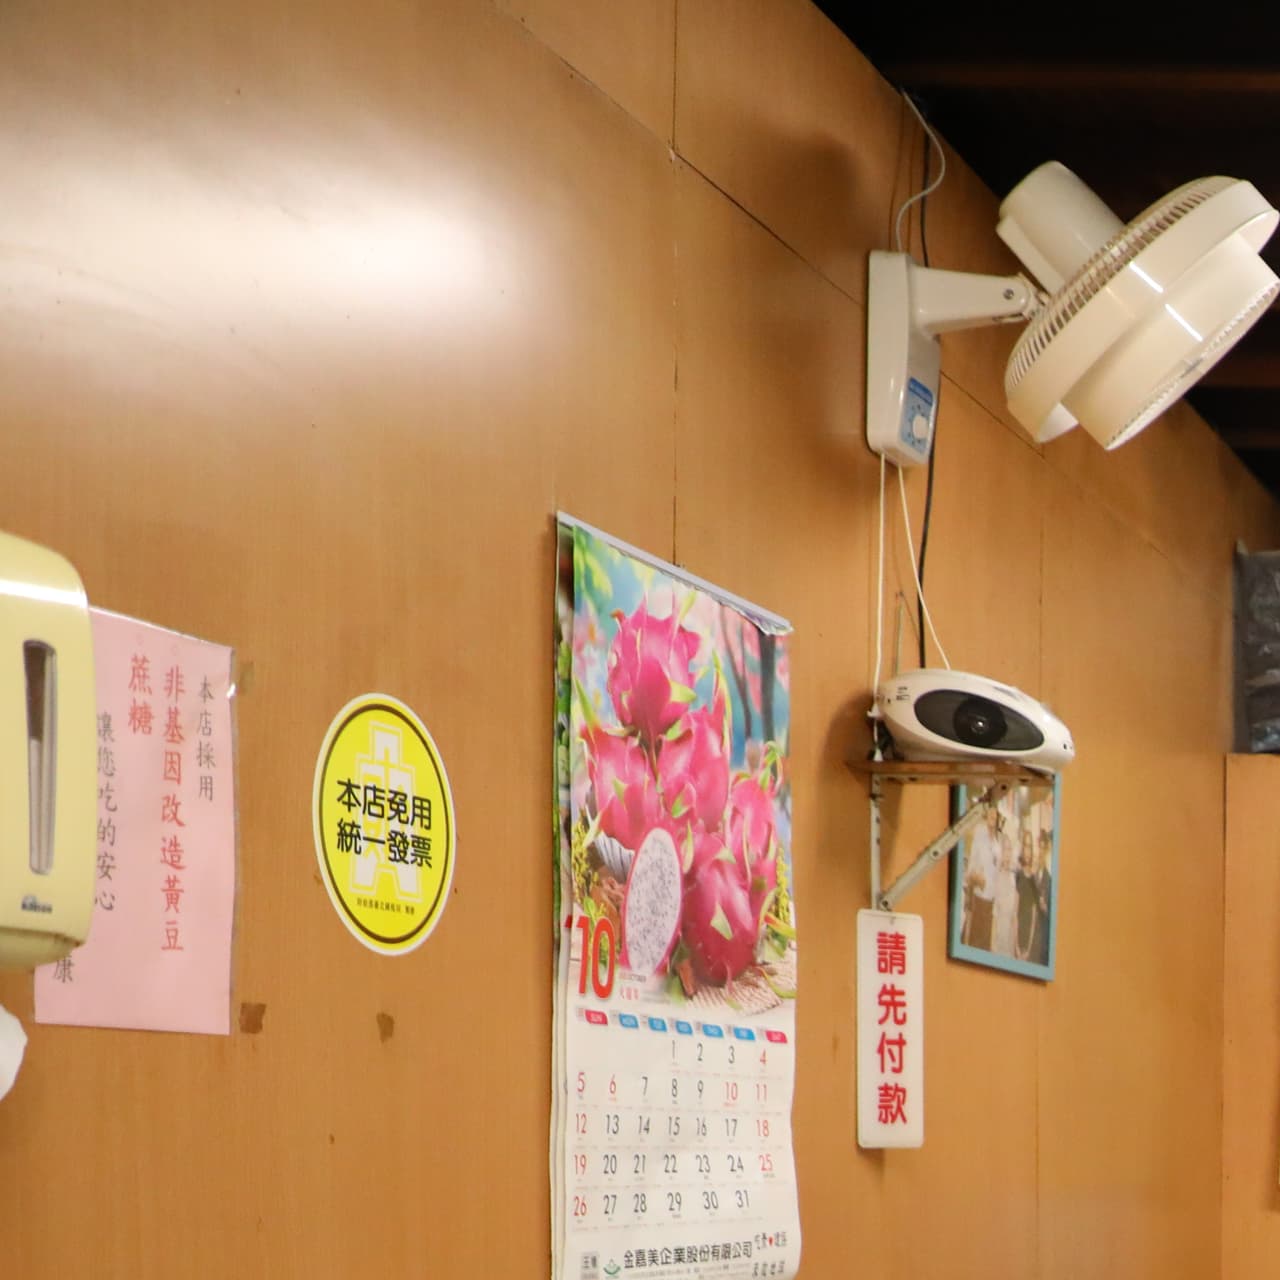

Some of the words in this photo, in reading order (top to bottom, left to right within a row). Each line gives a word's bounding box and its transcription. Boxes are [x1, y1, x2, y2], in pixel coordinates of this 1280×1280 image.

[127, 653, 155, 736] 蔗糖
[196, 675, 217, 802] 本店採用
[160, 665, 187, 953] 非基因改造黃豆
[337, 778, 432, 831] 本店免用
[337, 818, 432, 869] 統一發票
[576, 914, 615, 1001] 10
[671, 1040, 677, 1060] 1
[697, 1042, 704, 1062] 2
[728, 1045, 735, 1065] 3
[759, 1049, 767, 1065] 4
[876, 930, 908, 1126] 請先付款
[576, 1072, 585, 1094] 5
[609, 1074, 617, 1095] 6
[641, 1076, 649, 1096] 7
[671, 1078, 678, 1098] 8
[697, 1080, 704, 1099] 9
[724, 1081, 738, 1101] 10
[756, 1083, 767, 1101] 11
[575, 1113, 587, 1135] 12
[606, 1114, 620, 1135] 13
[638, 1115, 650, 1135] 14
[668, 1116, 681, 1136] 15
[696, 1117, 707, 1137] 16
[725, 1118, 738, 1137] 17
[756, 1119, 770, 1138] 18
[574, 1154, 587, 1175] 19
[603, 1154, 617, 1175] 20
[633, 1154, 646, 1174] 21
[664, 1154, 678, 1174] 22
[696, 1154, 711, 1173] 23
[727, 1154, 744, 1173] 24
[758, 1153, 773, 1172] 25
[574, 1195, 587, 1217] 26
[603, 1194, 617, 1215] 27
[633, 1193, 647, 1214] 28
[667, 1192, 682, 1212] 29
[702, 1190, 719, 1210] 30
[735, 1189, 750, 1209] 31
